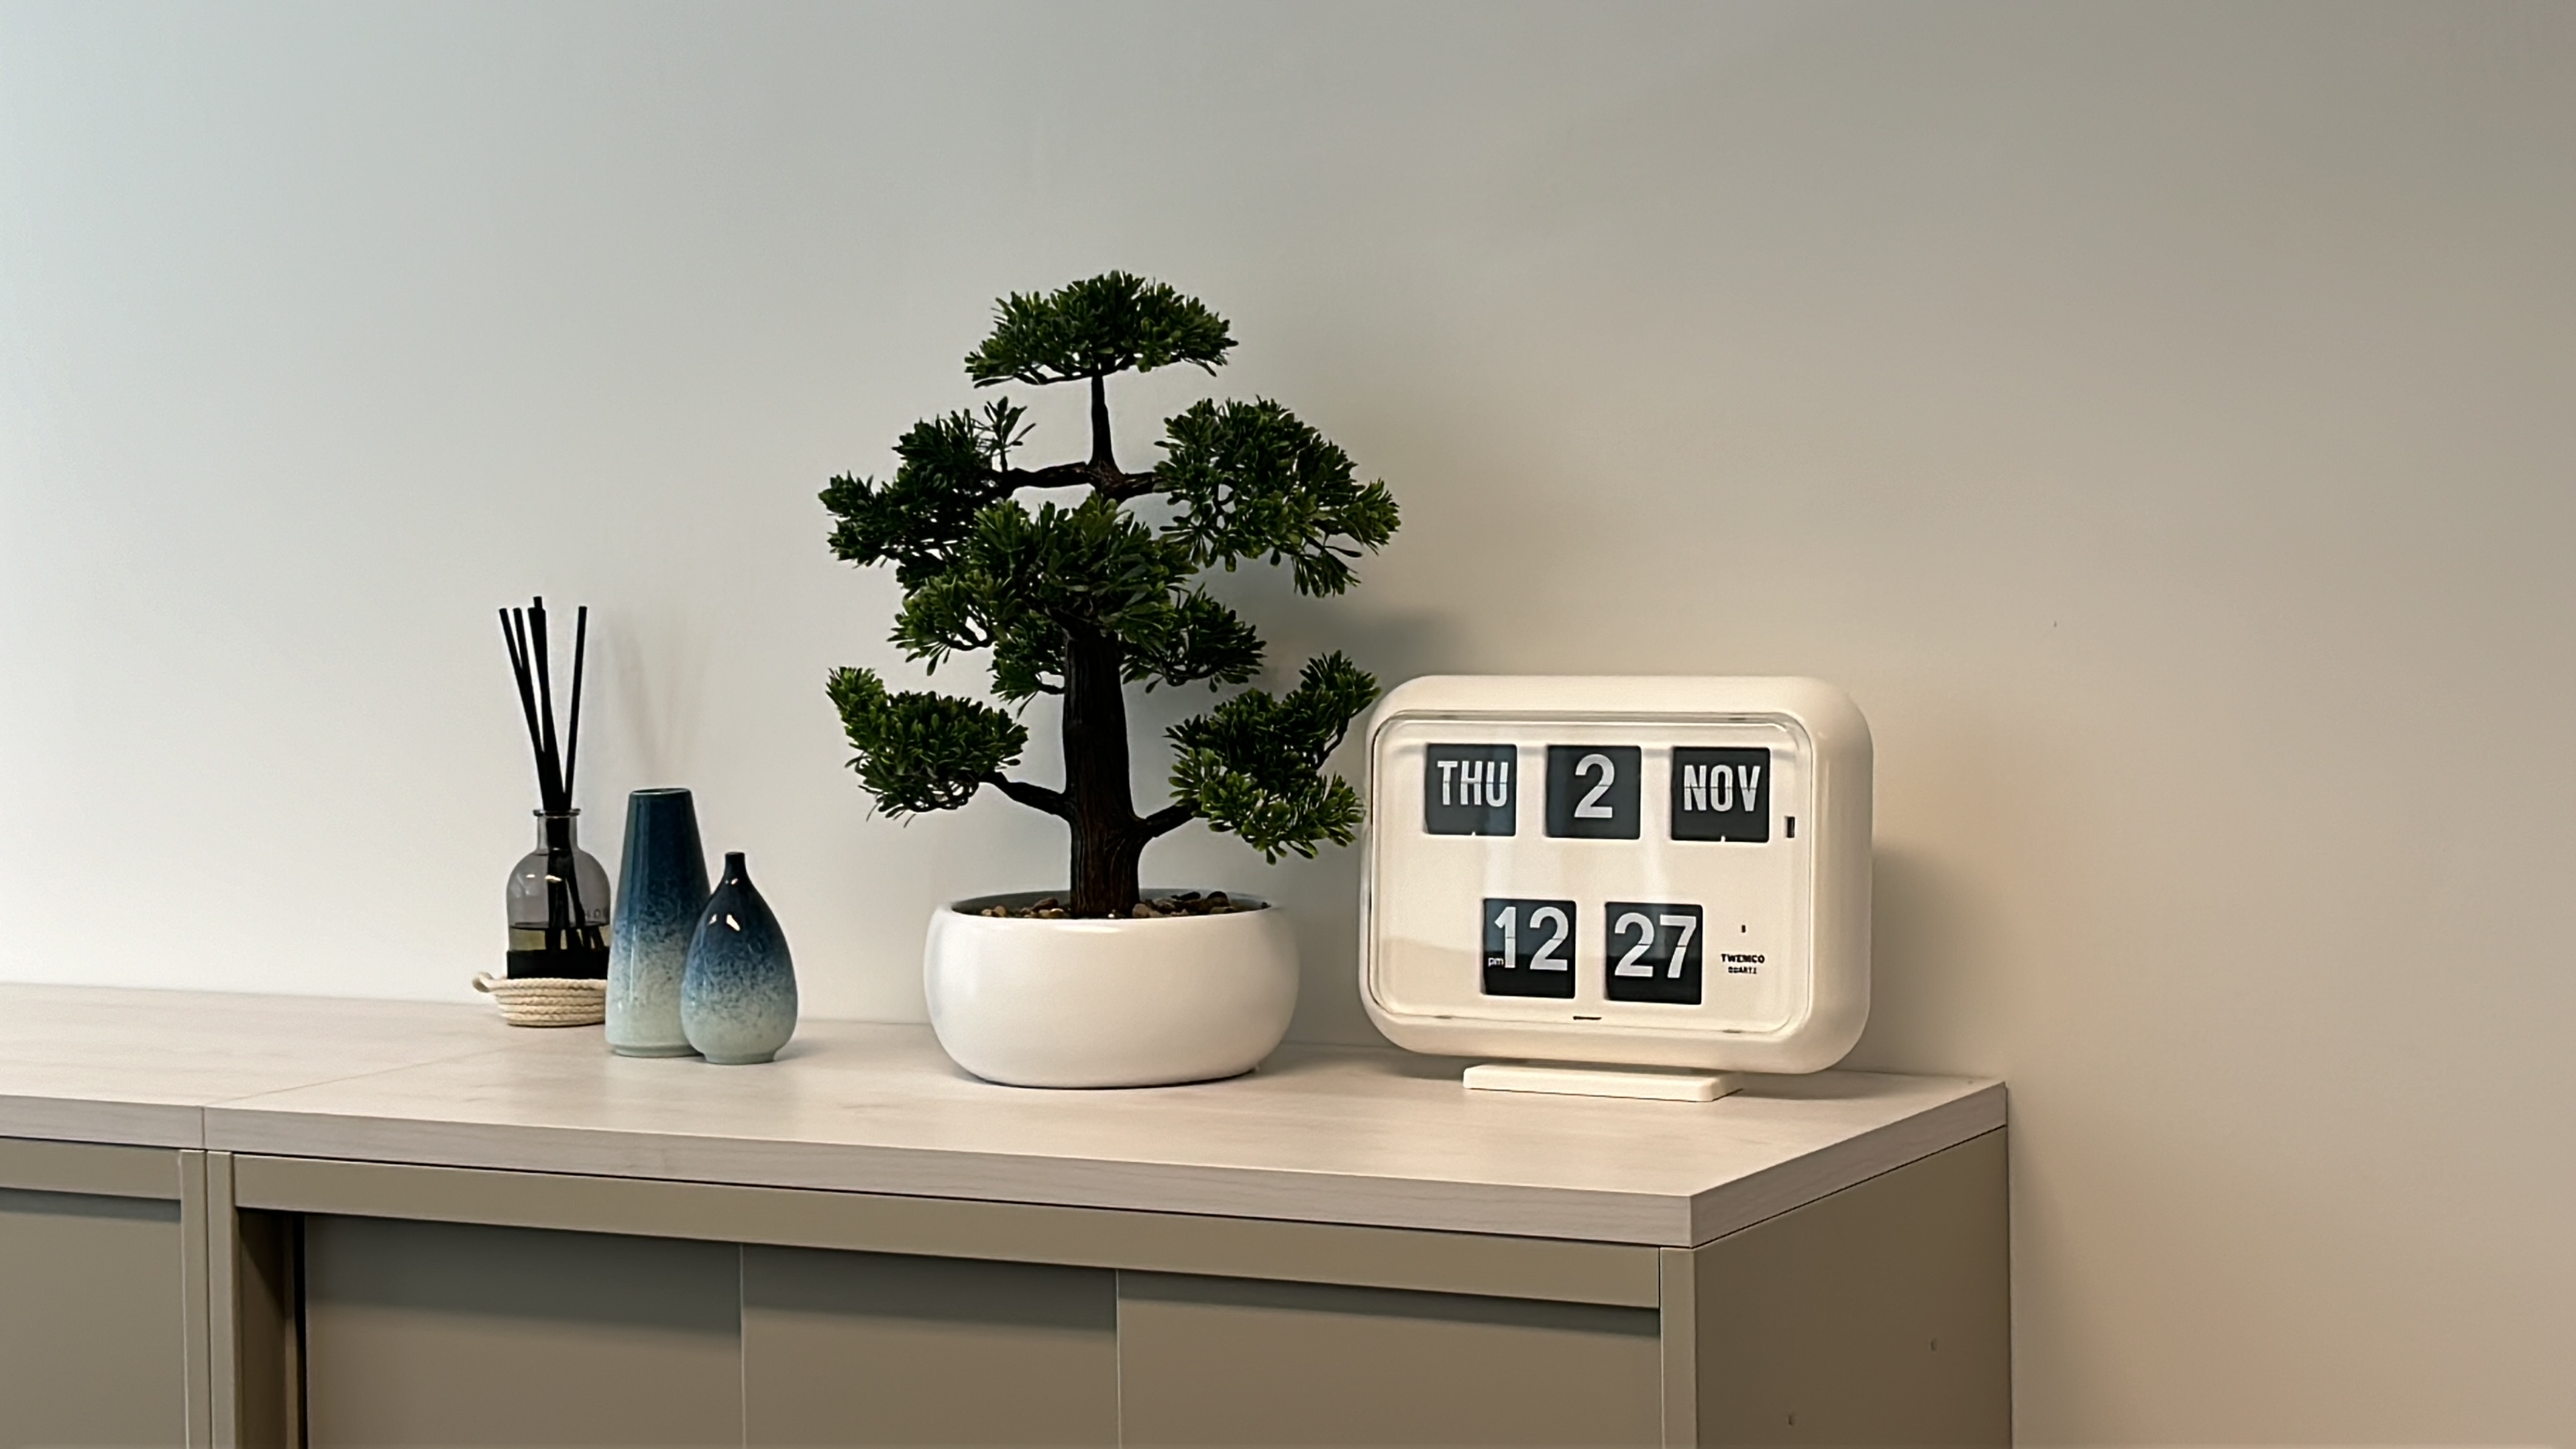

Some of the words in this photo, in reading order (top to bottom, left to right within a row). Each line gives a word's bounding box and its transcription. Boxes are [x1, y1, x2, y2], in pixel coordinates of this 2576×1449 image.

[1437, 760, 1509, 807] THU
[1573, 753, 1615, 818] 2
[1682, 764, 1761, 812] NOV
[1487, 957, 1504, 967] pm
[1494, 906, 1569, 971] 12
[1614, 912, 1697, 979] 27
[1721, 953, 1766, 964] TWEMCO
